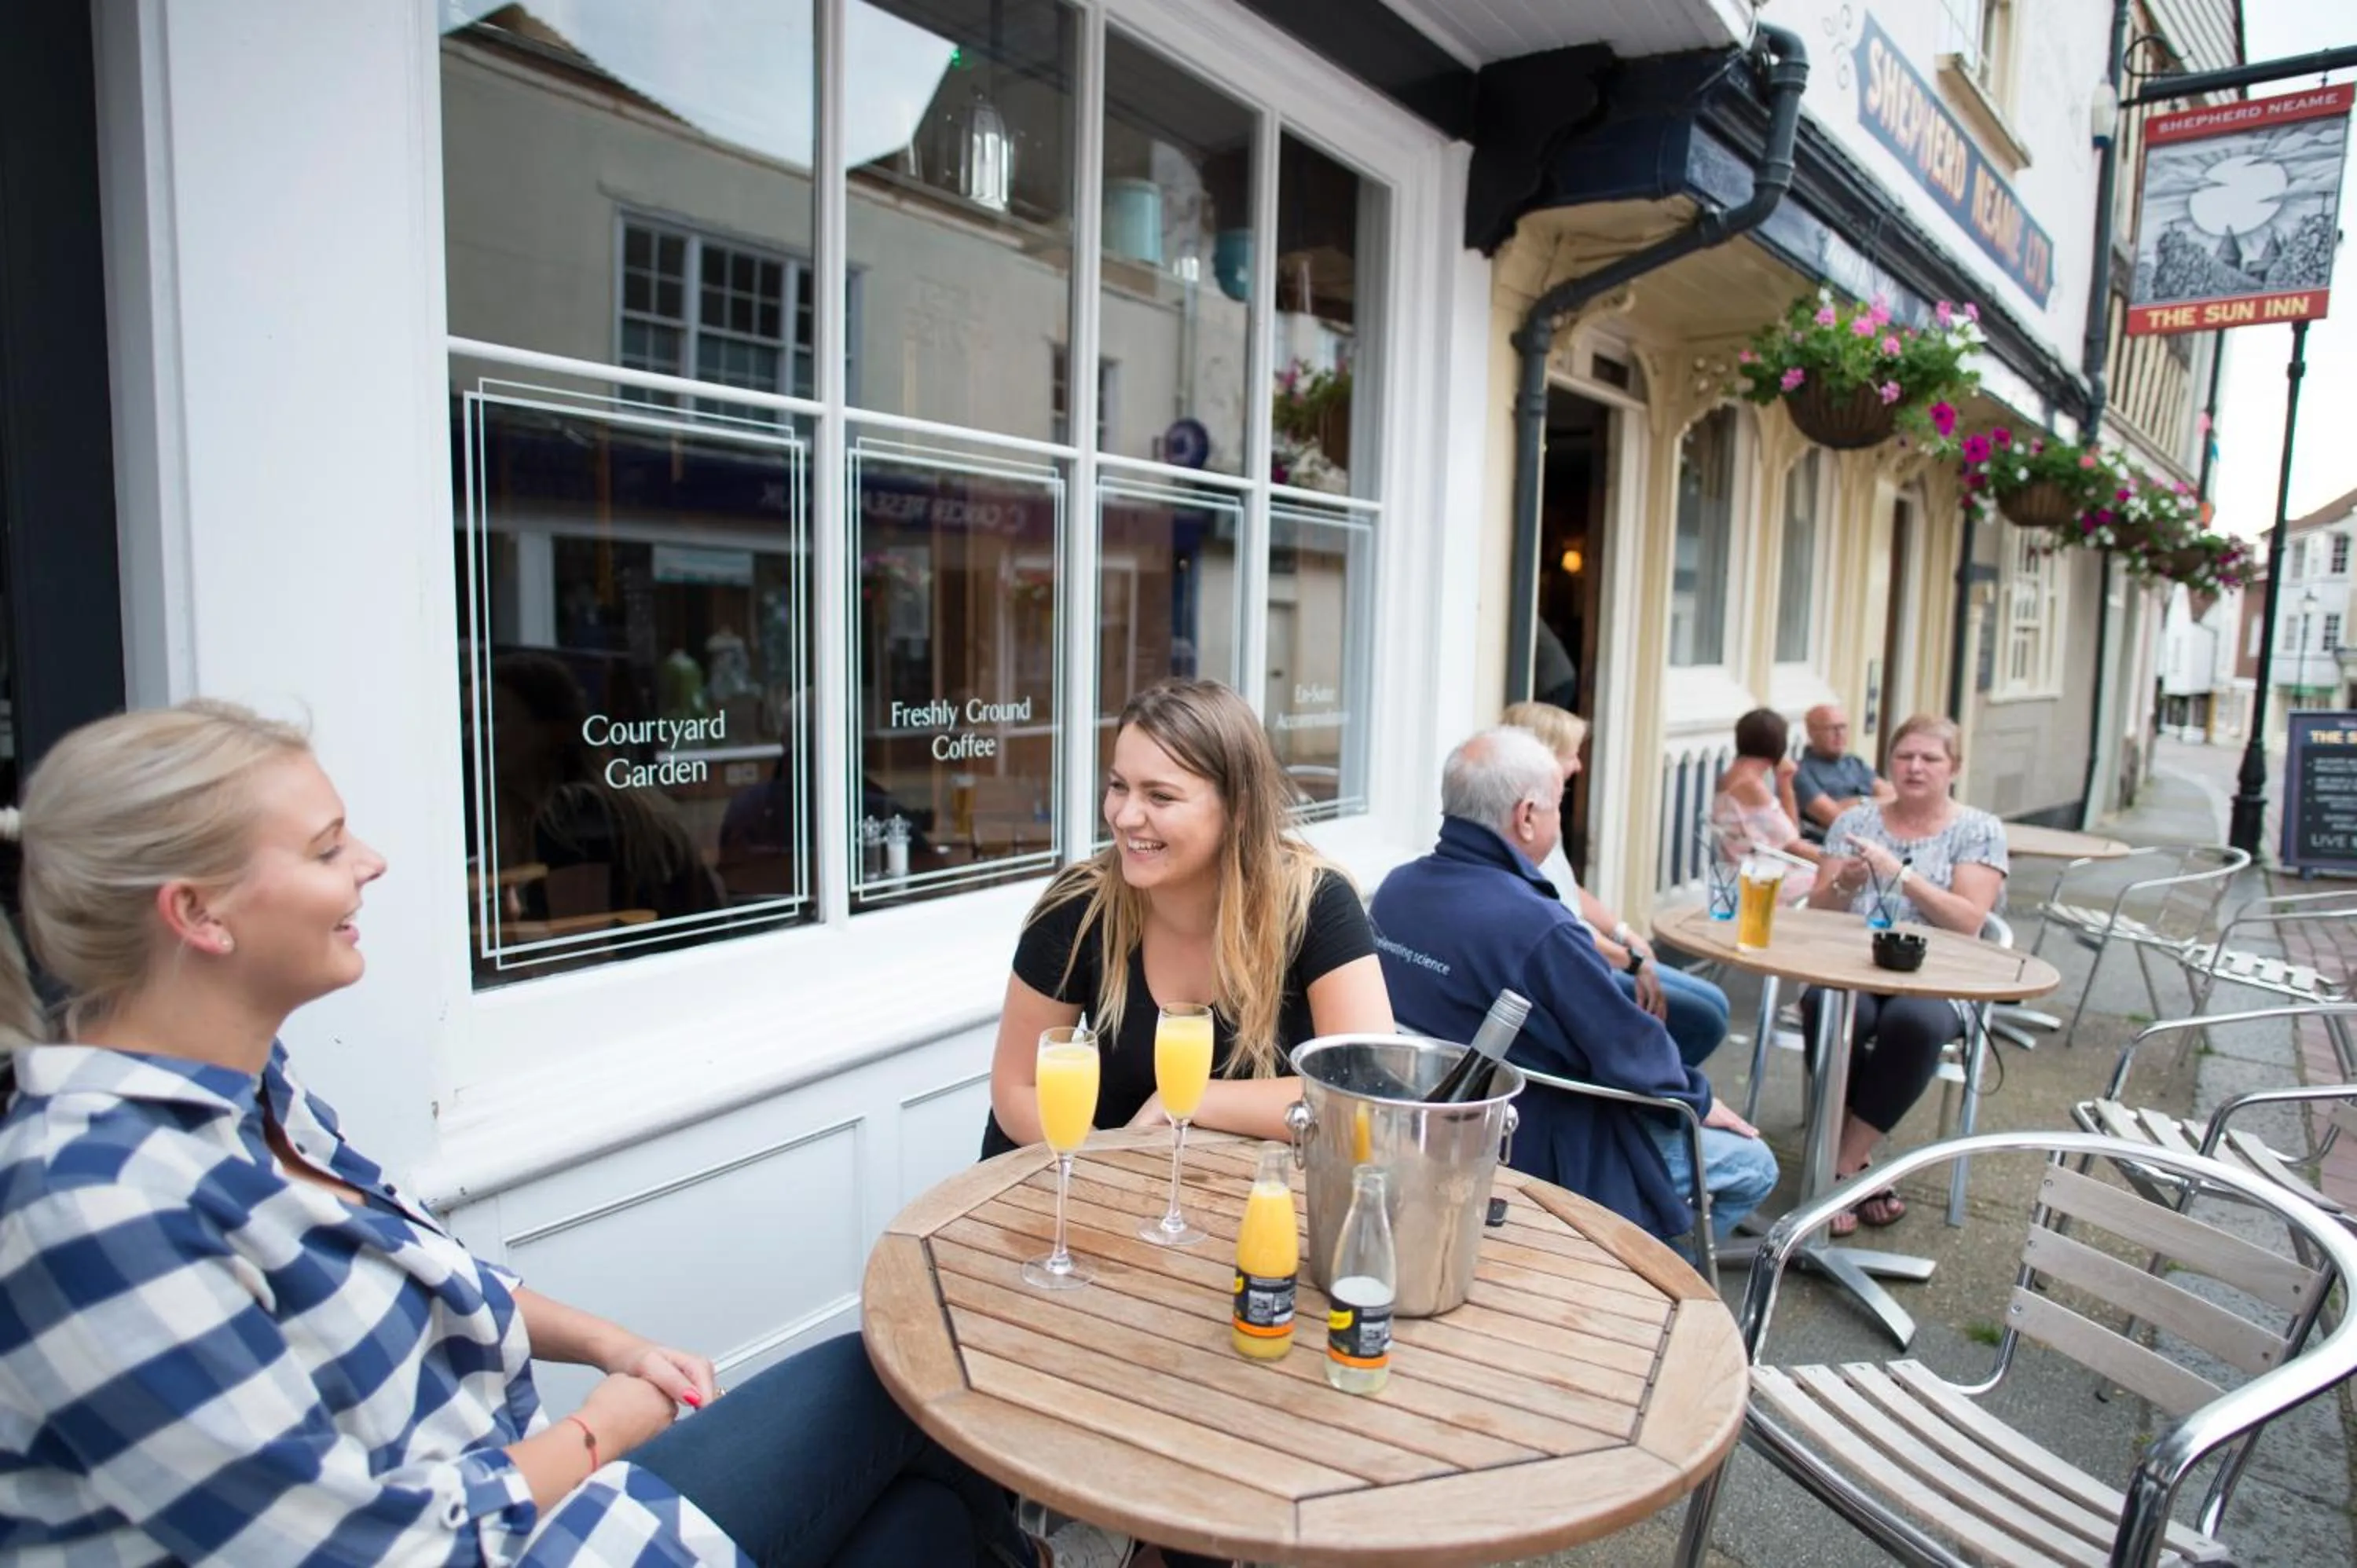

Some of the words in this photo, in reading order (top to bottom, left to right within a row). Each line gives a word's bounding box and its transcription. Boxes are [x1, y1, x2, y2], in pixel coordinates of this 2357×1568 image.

[2157, 107, 2262, 134] SHEPHERD
[2267, 92, 2339, 115] NEAME
[1865, 37, 1968, 206] SHEPHERD
[1972, 162, 2024, 269] NEAME
[2146, 306, 2198, 329] THE
[2203, 300, 2257, 324] SUN
[2264, 295, 2311, 318] INN
[581, 709, 726, 750] Courtyard
[891, 698, 959, 732] Freshly
[966, 694, 1032, 724] Ground
[932, 732, 997, 761] Coffee
[604, 754, 708, 789] Garden
[1413, 952, 1450, 976] science
